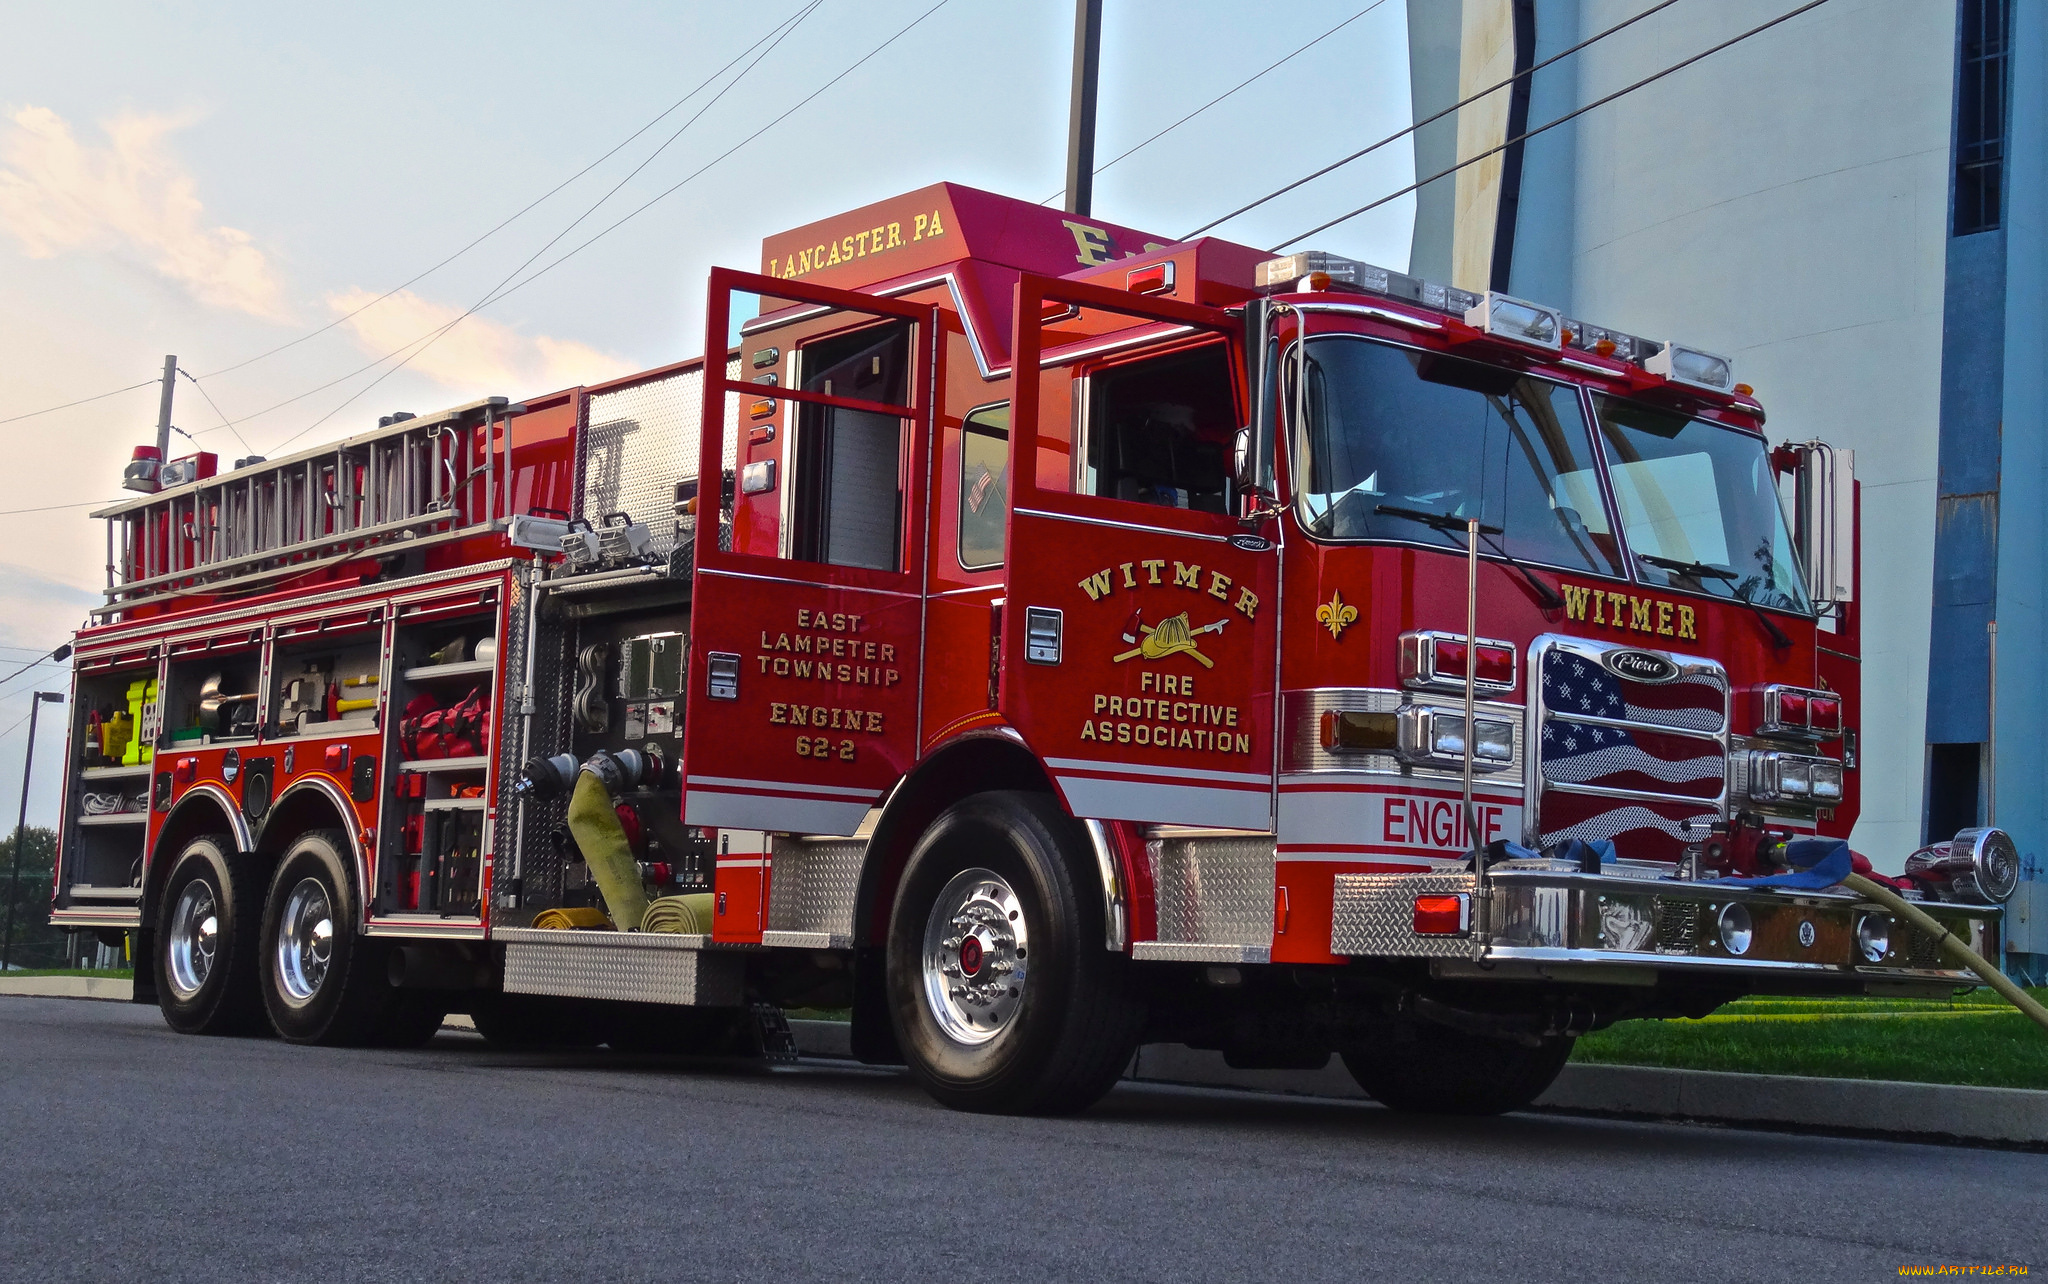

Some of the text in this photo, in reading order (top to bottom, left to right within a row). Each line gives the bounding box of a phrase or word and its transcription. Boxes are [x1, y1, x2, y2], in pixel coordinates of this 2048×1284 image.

[913, 210, 944, 241] PA
[1078, 559, 1260, 619] WITMER
[798, 608, 861, 632] EAST
[1561, 583, 1697, 639] WITMER
[761, 630, 894, 662] LAMPETER
[757, 655, 899, 686] TOWNSHIP
[1618, 653, 1662, 674] Pierce
[1141, 671, 1193, 696] FIRE
[769, 702, 883, 732] ENGINE
[1094, 694, 1238, 727] PROTECTIVE
[1080, 720, 1249, 754] ASSOCIATION
